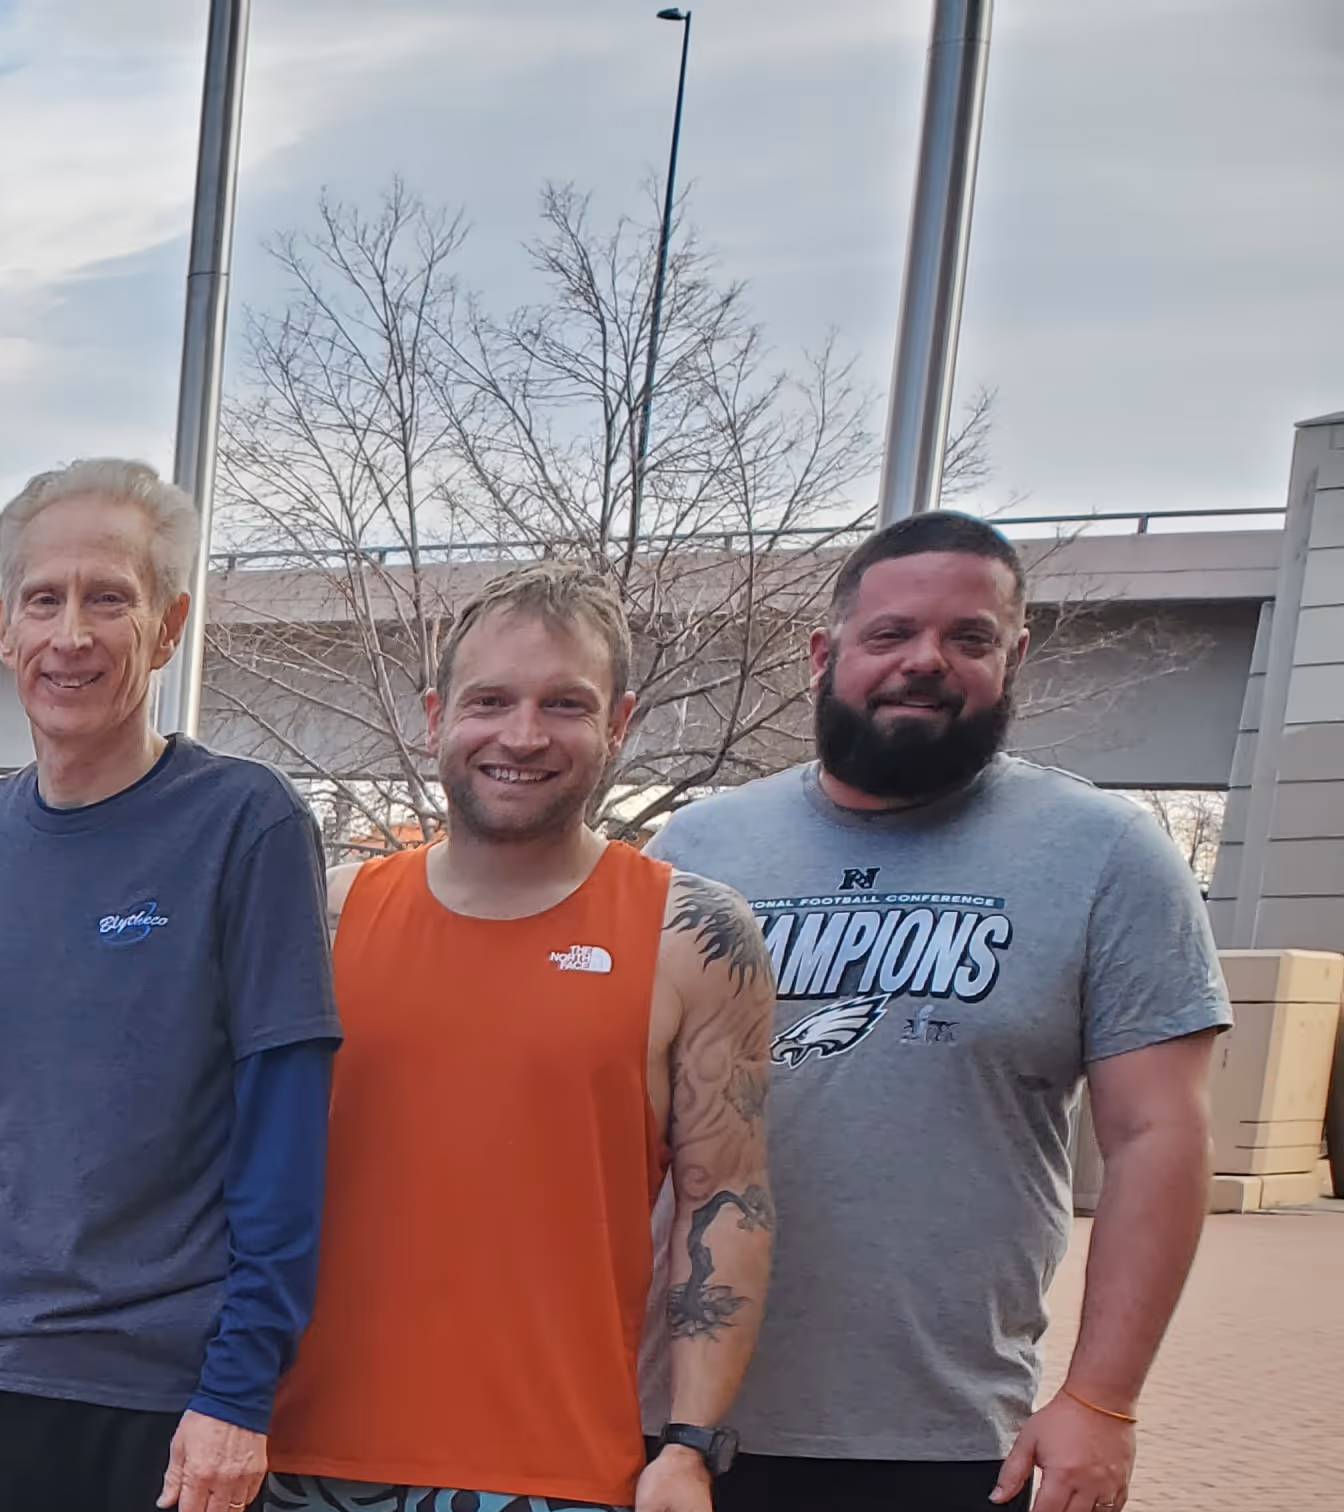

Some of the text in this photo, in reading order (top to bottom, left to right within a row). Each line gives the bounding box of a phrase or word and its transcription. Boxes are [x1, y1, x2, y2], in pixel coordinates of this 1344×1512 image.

[751, 894, 994, 909] IONAL FOOTBALL CONFERENCE
[99, 911, 169, 934] Blytheco
[550, 952, 591, 962] NORTH
[759, 908, 1011, 1001] AMPIONS
